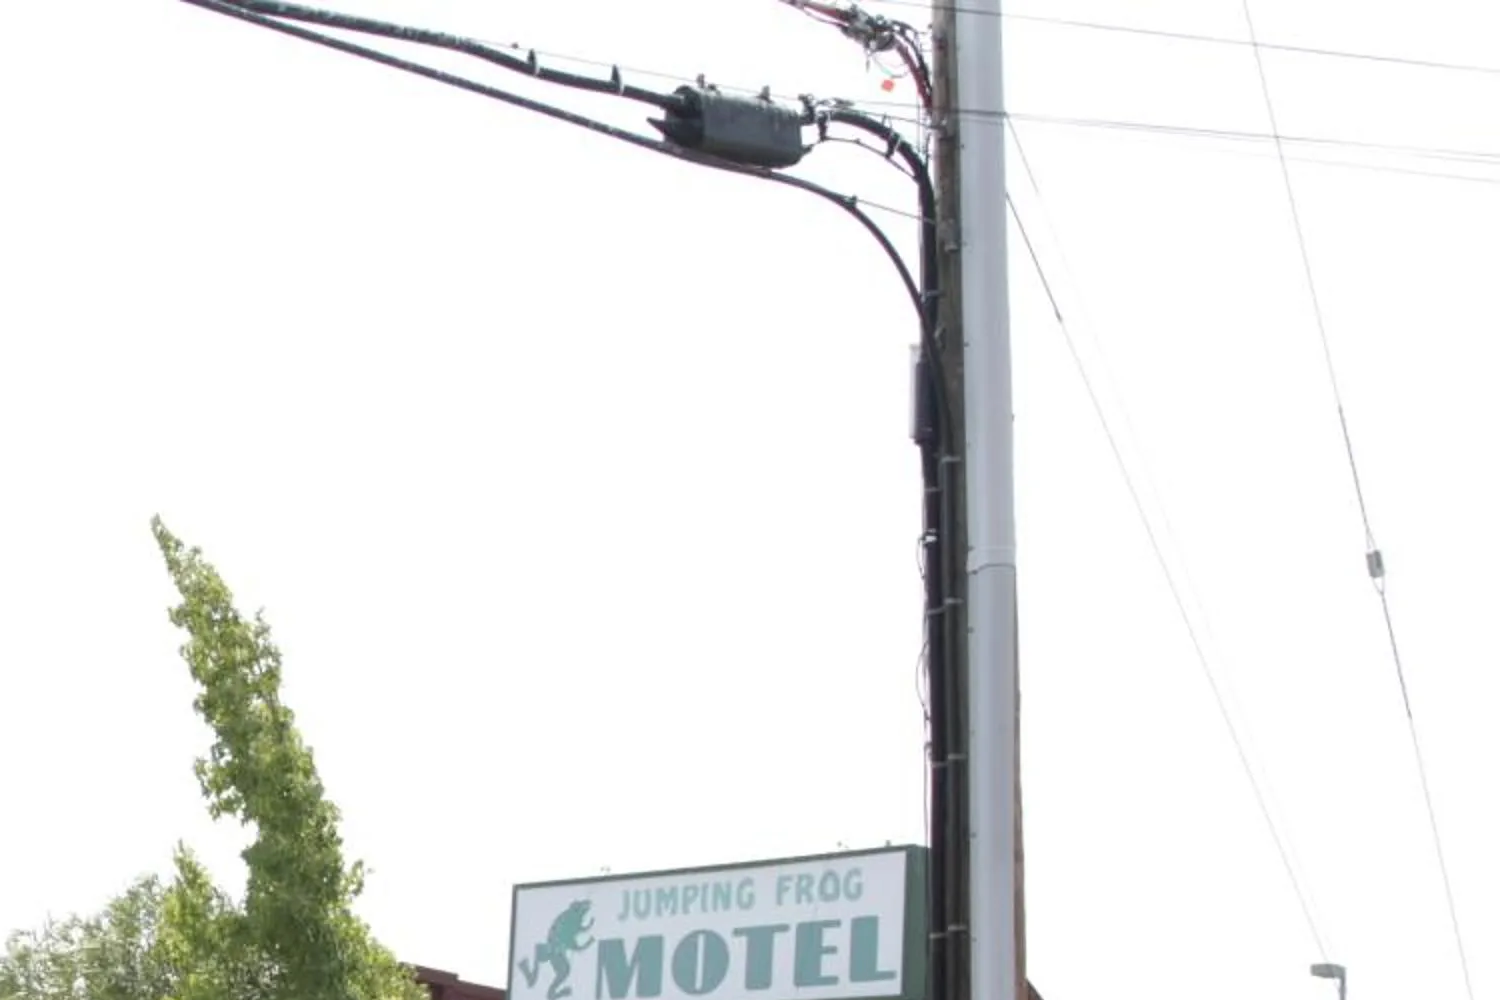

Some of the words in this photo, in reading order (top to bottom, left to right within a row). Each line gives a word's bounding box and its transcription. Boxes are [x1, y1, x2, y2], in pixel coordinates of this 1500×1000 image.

[617, 877, 756, 922] JUMPING
[775, 867, 864, 905] FROG
[594, 914, 898, 1000] MOTEL
